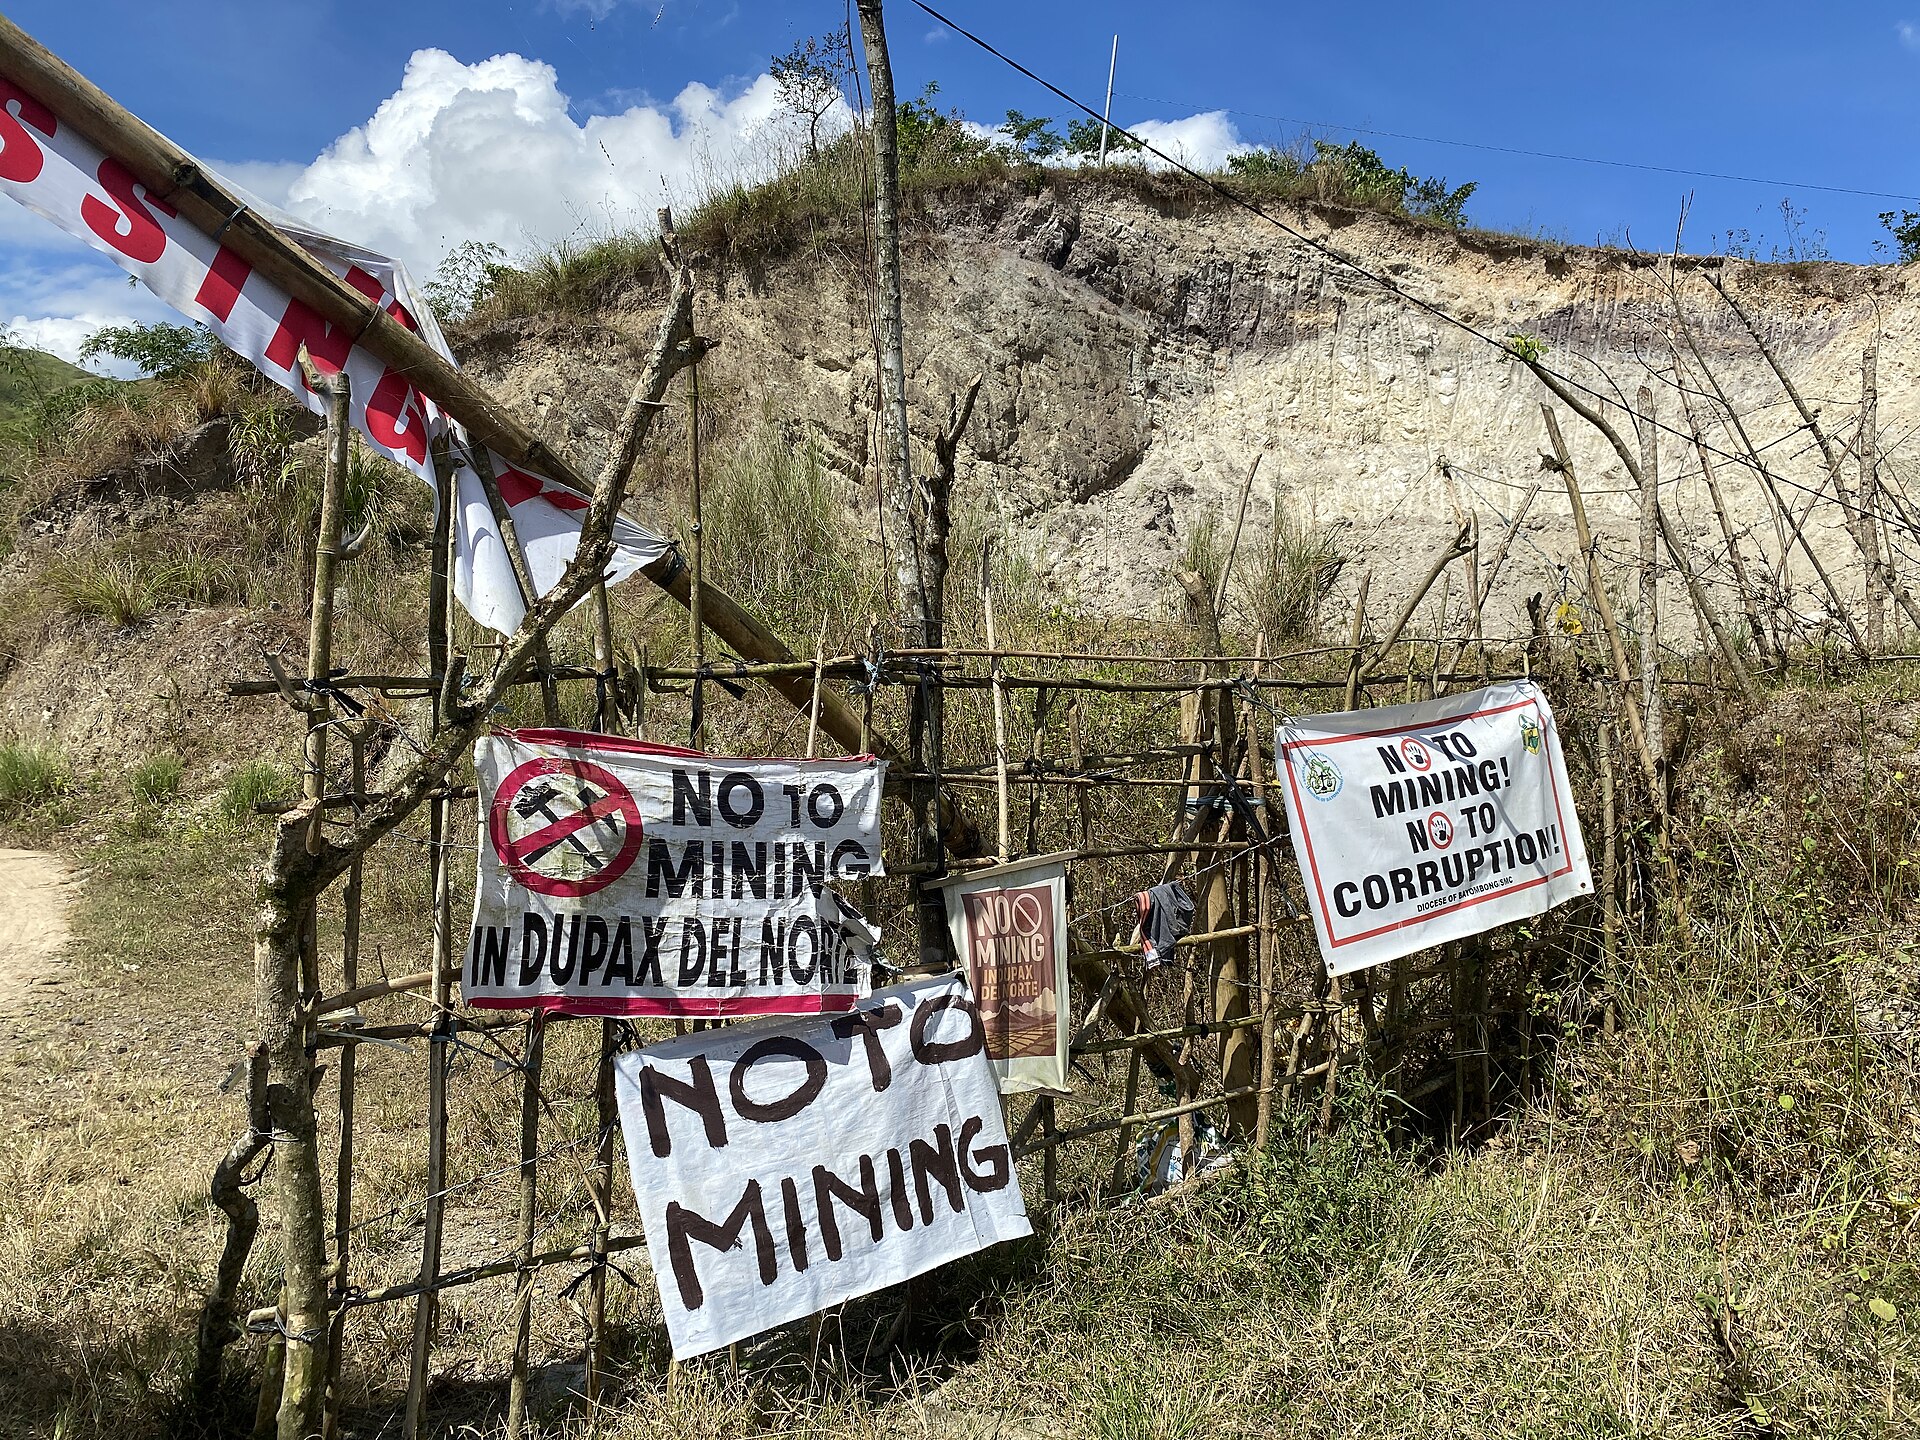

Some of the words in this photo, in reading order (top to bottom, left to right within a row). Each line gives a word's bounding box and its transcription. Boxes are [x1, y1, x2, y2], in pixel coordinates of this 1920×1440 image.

[1432, 731, 1478, 762] TO
[672, 769, 765, 829] NO
[783, 783, 844, 829] TO
[1369, 756, 1511, 818] MINING!
[1461, 802, 1496, 838] TO
[646, 838, 871, 900] MINING
[1333, 823, 1560, 918] CORRUPTION!
[1417, 896, 1447, 912] DIOCESE
[1448, 893, 1457, 903] OF
[1459, 880, 1499, 899] BAYOMBONG
[1500, 876, 1513, 886] SMC
[973, 895, 1011, 936] NO
[471, 926, 511, 987] IN
[519, 912, 669, 987] DUPAX
[679, 916, 747, 987] DEL
[975, 933, 1045, 968] MINING
[983, 969, 997, 984] IN
[640, 1035, 829, 1158] NO
[830, 994, 986, 1093] TO
[666, 1115, 1011, 1311] MINING
